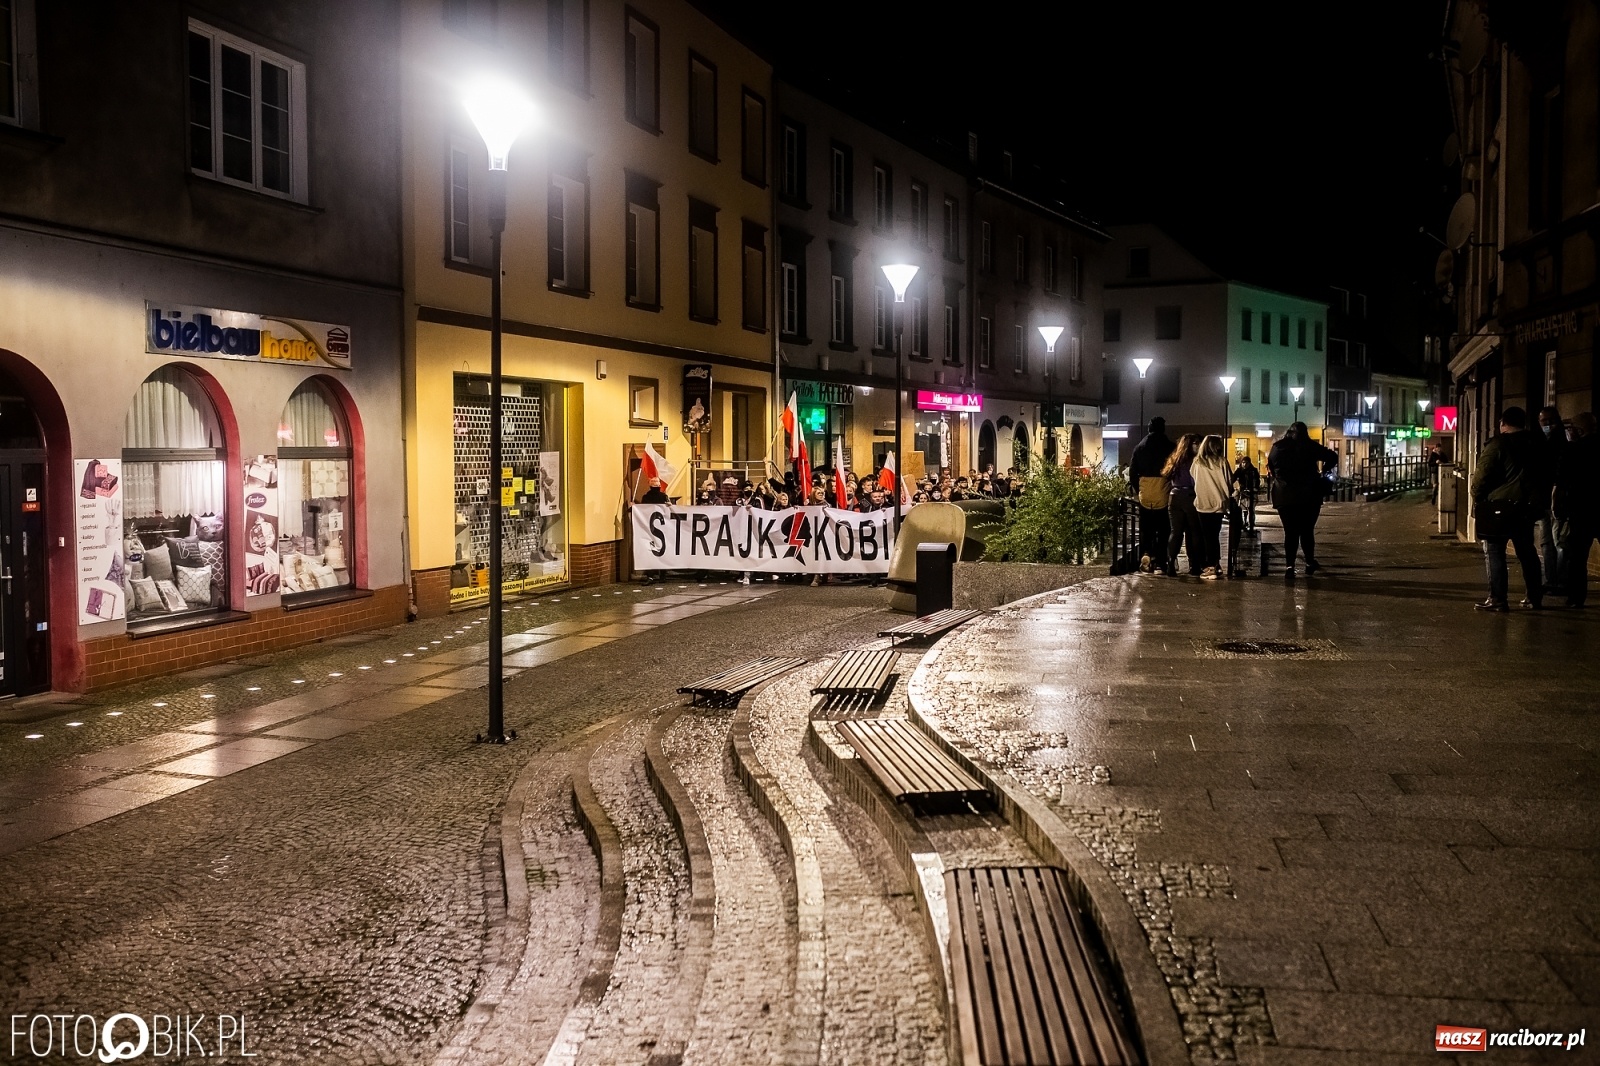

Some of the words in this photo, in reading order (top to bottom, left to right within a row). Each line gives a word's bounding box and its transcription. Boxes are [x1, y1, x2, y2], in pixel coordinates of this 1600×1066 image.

[261, 330, 317, 361] home
[817, 382, 854, 404] TATTOO
[650, 511, 778, 560] STRAJK
[814, 515, 906, 562] KOBI
